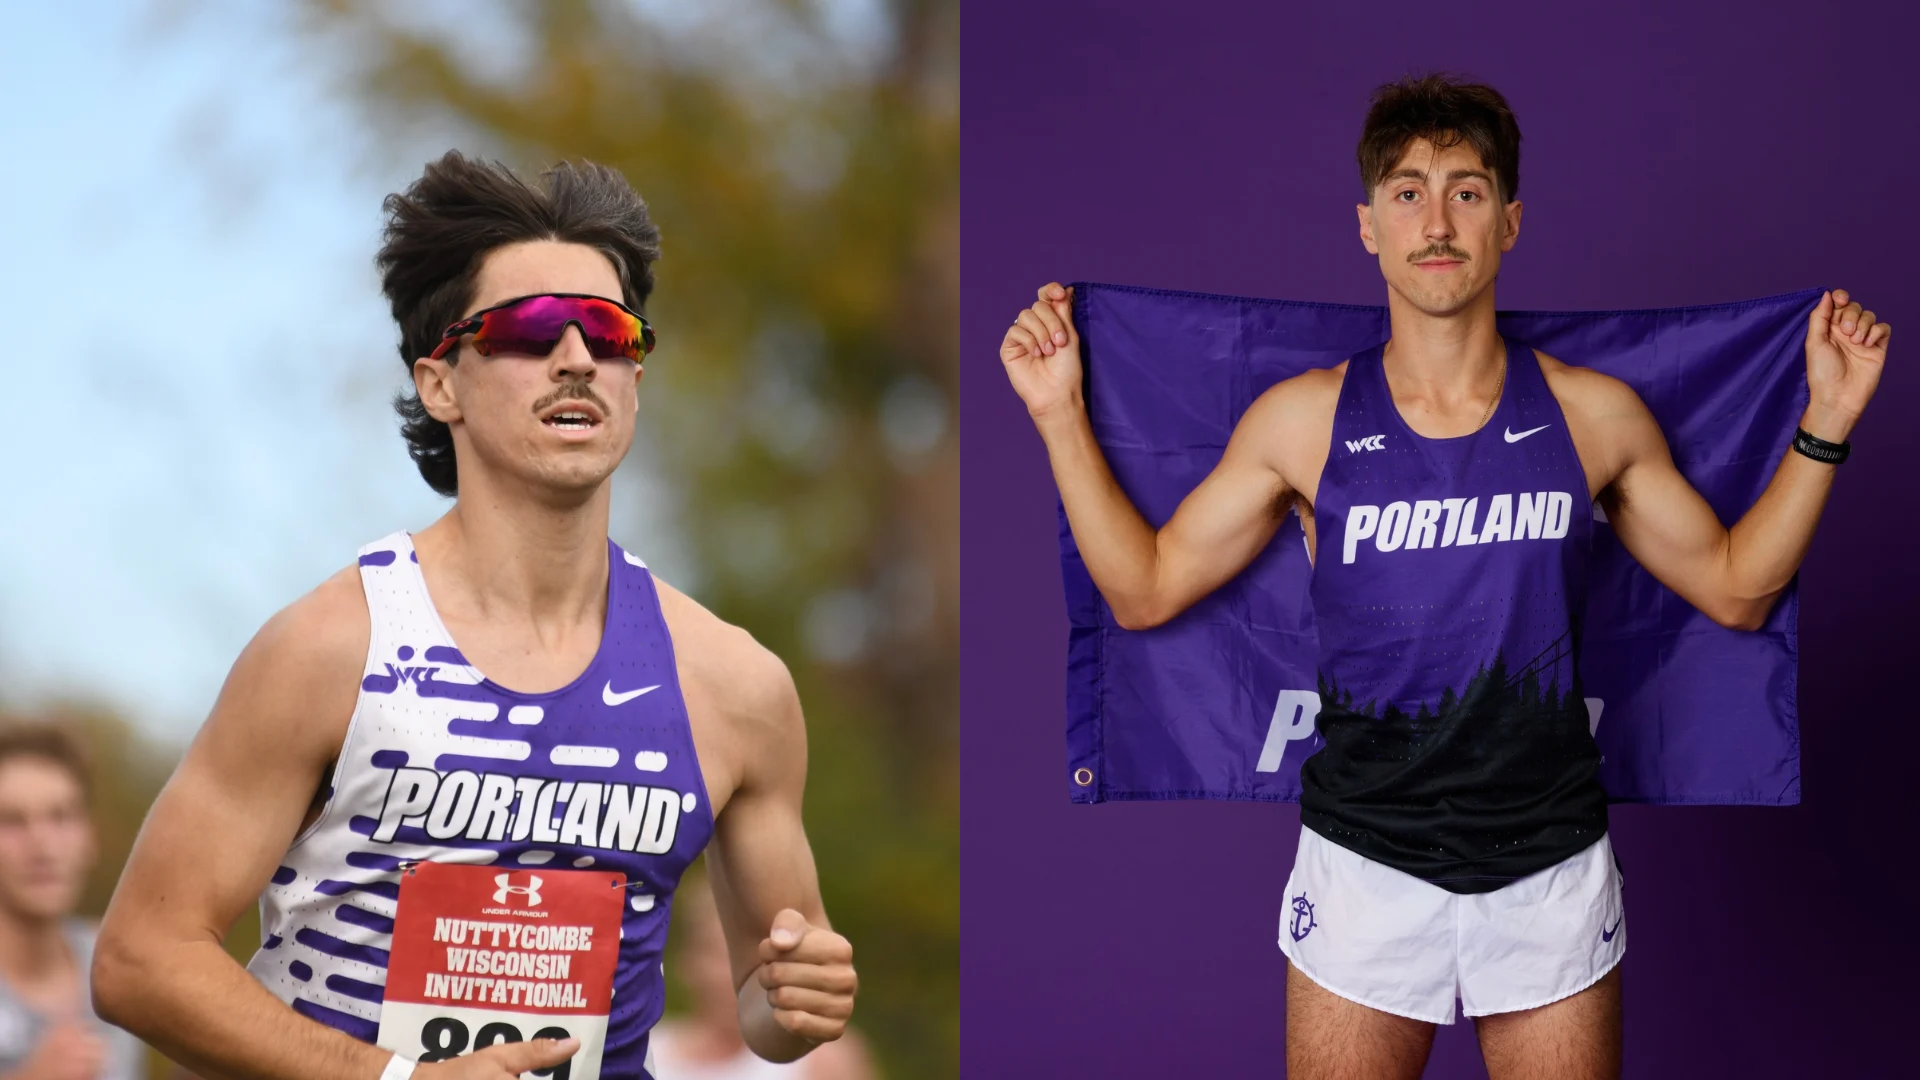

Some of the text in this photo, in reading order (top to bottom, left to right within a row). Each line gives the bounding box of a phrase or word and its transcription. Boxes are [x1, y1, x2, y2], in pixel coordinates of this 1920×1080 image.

[1344, 434, 1386, 454] WCC
[1342, 491, 1573, 565] PORTLAND
[368, 766, 682, 855] PORTLAND
[481, 908, 549, 919] UNDER ARMOUR
[433, 917, 594, 952] NUTTYCOMBE
[446, 947, 572, 980] WISCONSIN
[424, 973, 588, 1009] INVITATIONAL
